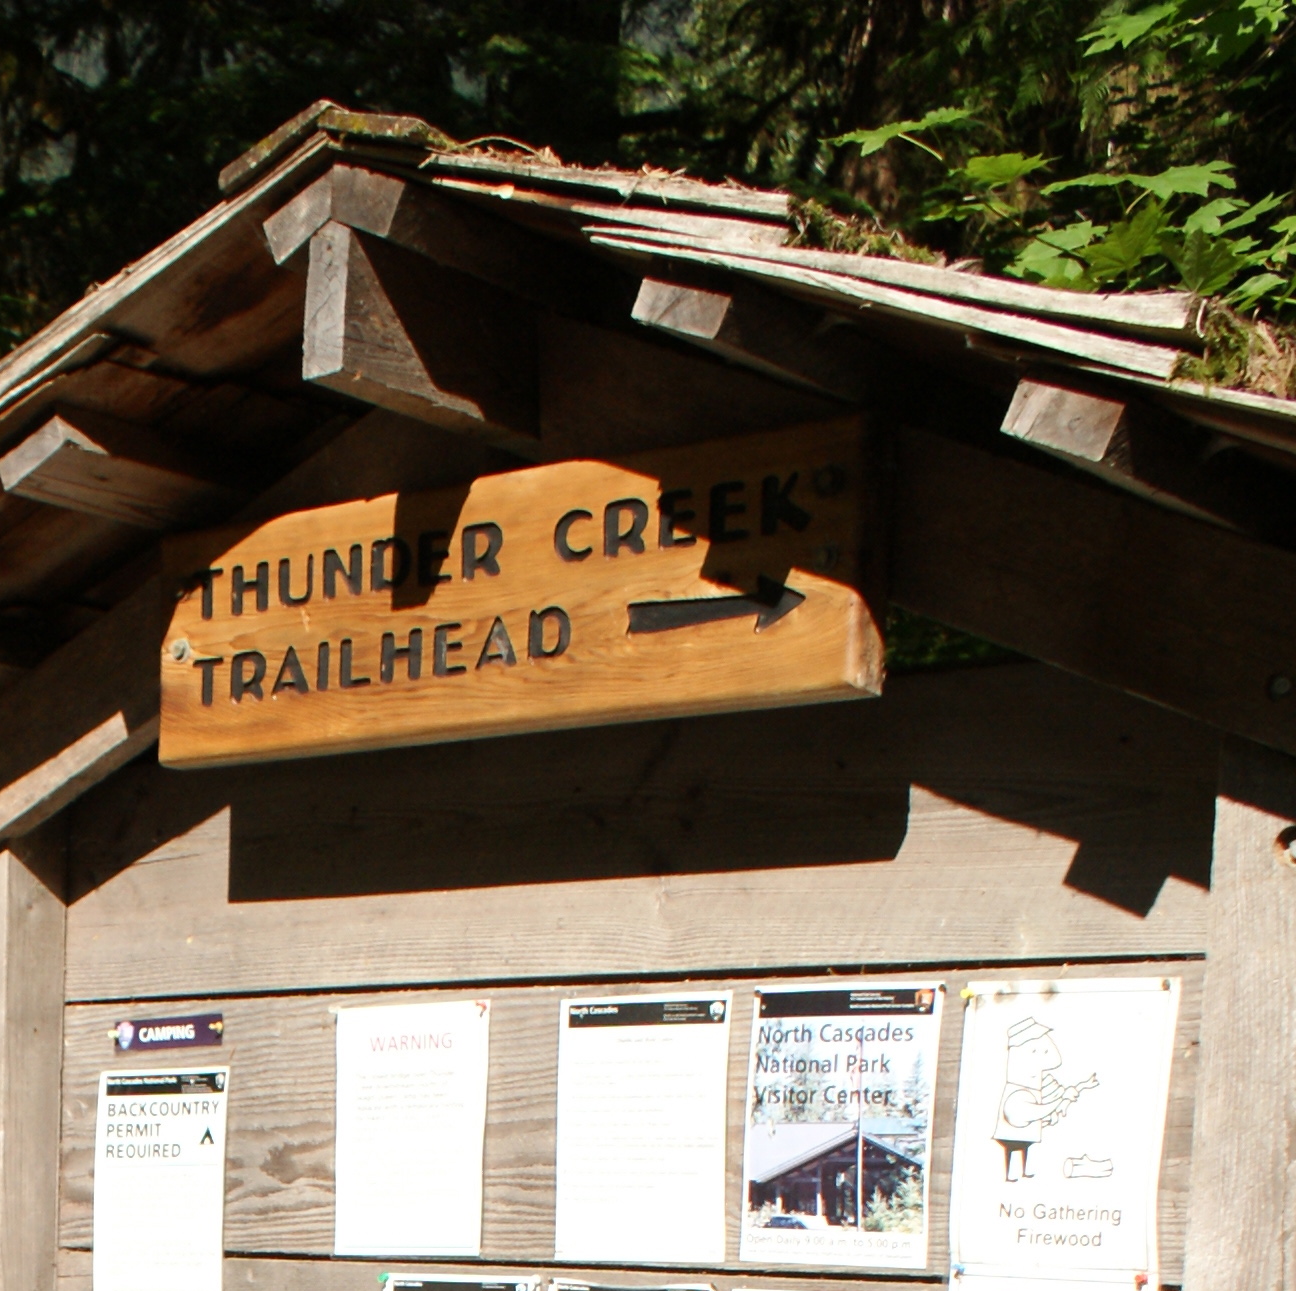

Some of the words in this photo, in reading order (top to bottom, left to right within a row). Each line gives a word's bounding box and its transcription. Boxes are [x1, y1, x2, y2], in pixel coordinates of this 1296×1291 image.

[193, 522, 504, 620] THUNDER
[554, 472, 815, 562] CREEK
[193, 604, 572, 707] TRAILHEAD
[138, 1024, 196, 1042] CAMPING
[369, 1032, 453, 1052] WARNING
[758, 1024, 812, 1044] North
[820, 1022, 914, 1043] Cascades
[756, 1054, 838, 1073] National
[846, 1053, 891, 1073] Park
[754, 1085, 816, 1105] Visitor
[824, 1085, 892, 1106] Center
[107, 1100, 220, 1117] BACKCOUNTRY
[106, 1123, 162, 1138] PERMIT
[106, 1143, 181, 1159] REQUIRED
[999, 1203, 1025, 1219] No
[1033, 1203, 1122, 1226] Gathering
[804, 1235, 825, 1246] 900
[868, 1238, 888, 1248] 500
[1016, 1228, 1102, 1247] Firewood
